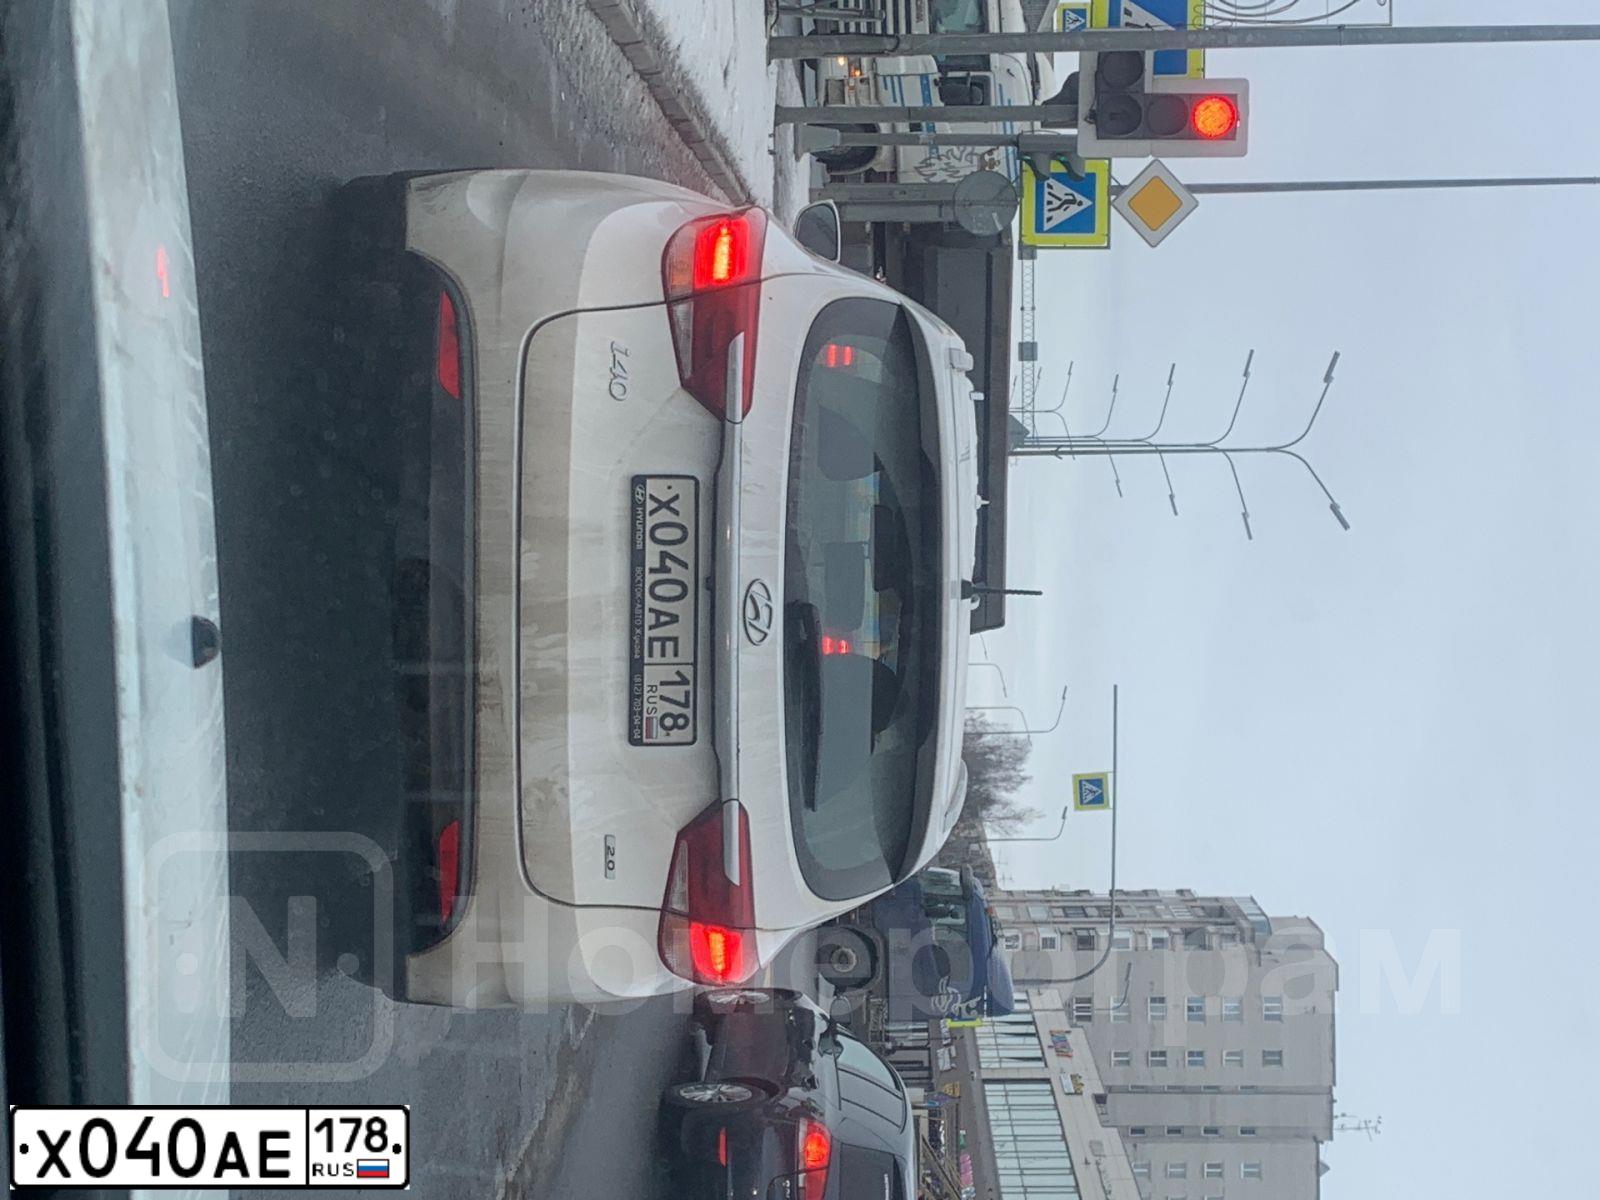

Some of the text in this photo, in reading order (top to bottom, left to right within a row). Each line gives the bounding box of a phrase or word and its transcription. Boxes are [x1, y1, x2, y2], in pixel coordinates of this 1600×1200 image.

[608, 340, 631, 401] i40
[633, 674, 642, 739] (812) 703-04-04
[646, 684, 658, 716] RUS
[659, 669, 691, 732] 178
